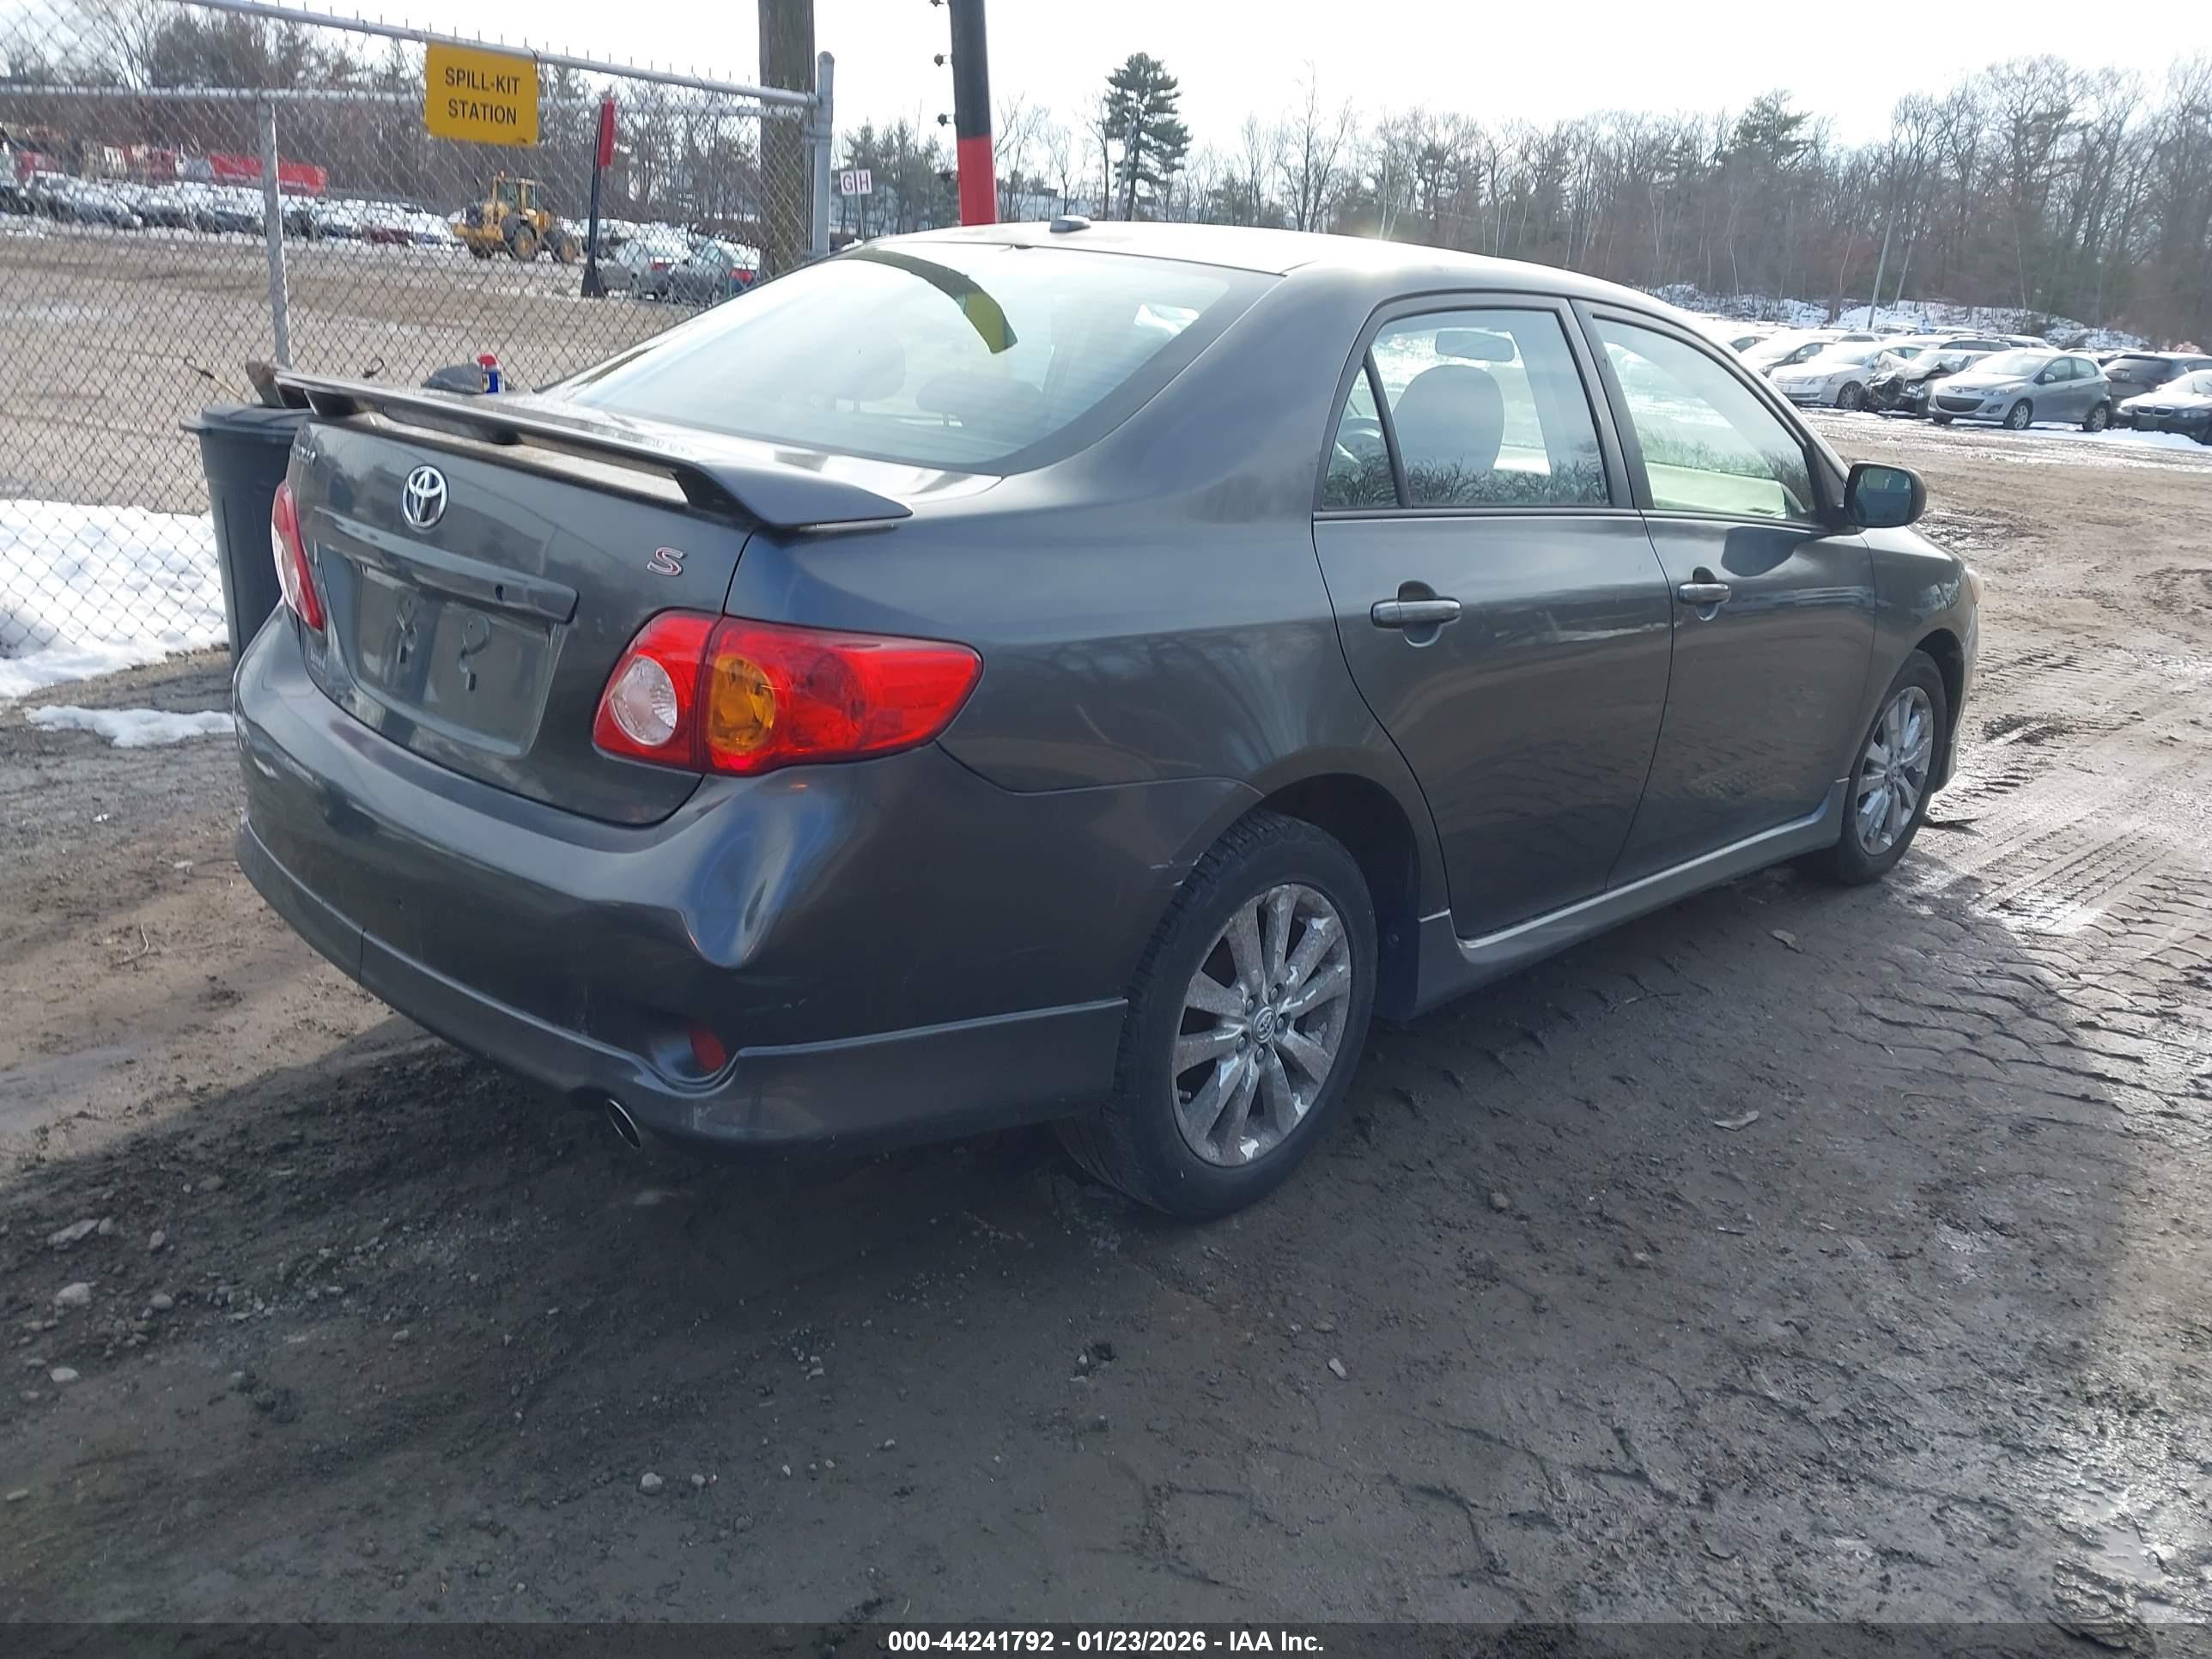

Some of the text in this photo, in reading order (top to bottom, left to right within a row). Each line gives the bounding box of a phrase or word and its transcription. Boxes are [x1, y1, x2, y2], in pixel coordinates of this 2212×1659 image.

[445, 66, 520, 96] SPILL-KIT
[447, 98, 517, 125] STATION
[646, 546, 684, 576] S
